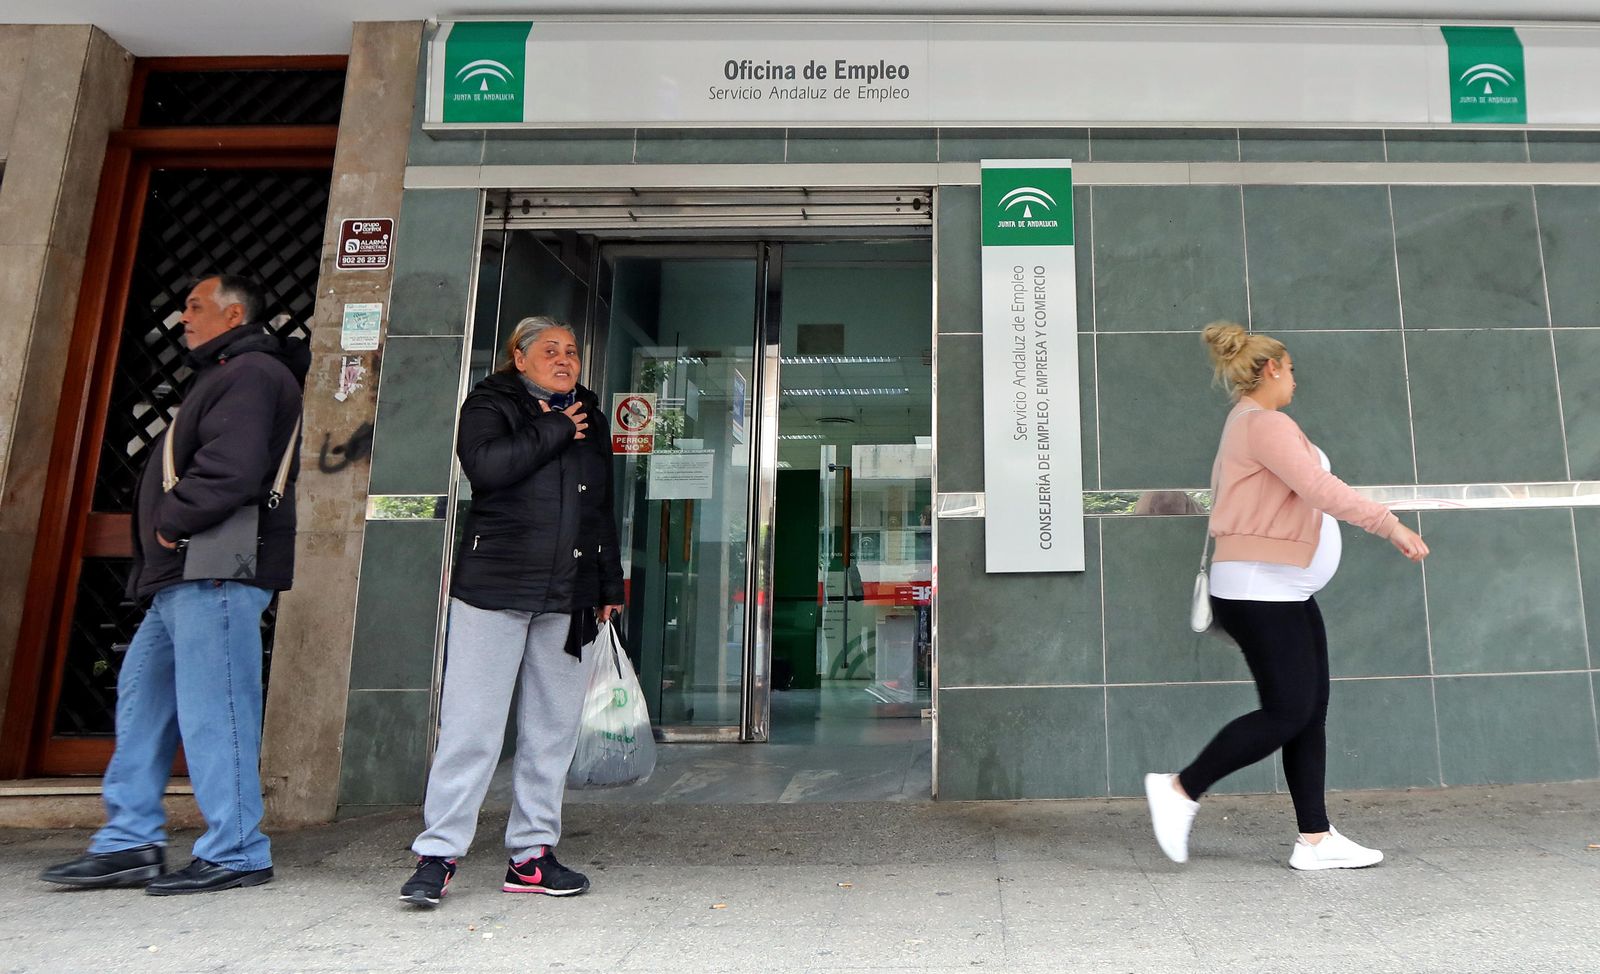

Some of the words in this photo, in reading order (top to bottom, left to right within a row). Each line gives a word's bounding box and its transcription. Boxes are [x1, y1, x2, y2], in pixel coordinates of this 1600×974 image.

[724, 60, 796, 80] Oficina
[803, 60, 827, 80] de
[834, 60, 910, 84] Empleo
[454, 93, 472, 101] JUNTA
[474, 93, 481, 101] DE
[709, 86, 762, 100] Servicio
[769, 86, 827, 100] Andaluz
[833, 86, 850, 99] de
[858, 86, 910, 102] Empleo
[998, 220, 1016, 228] JUNTA
[1018, 220, 1026, 228] DE
[357, 256, 366, 264] 26
[1011, 265, 1028, 312] Empleo
[1034, 265, 1047, 328] COMERCIO
[1012, 316, 1026, 332] de
[1035, 330, 1047, 338] Y
[1012, 335, 1026, 388] Andaluz
[1035, 340, 1048, 395] EMPRESA
[1013, 391, 1028, 441] Servicio
[1037, 398, 1050, 450] EMPLEO,
[1038, 454, 1050, 470] DE
[1036, 473, 1052, 550] CONSEJERÍA
